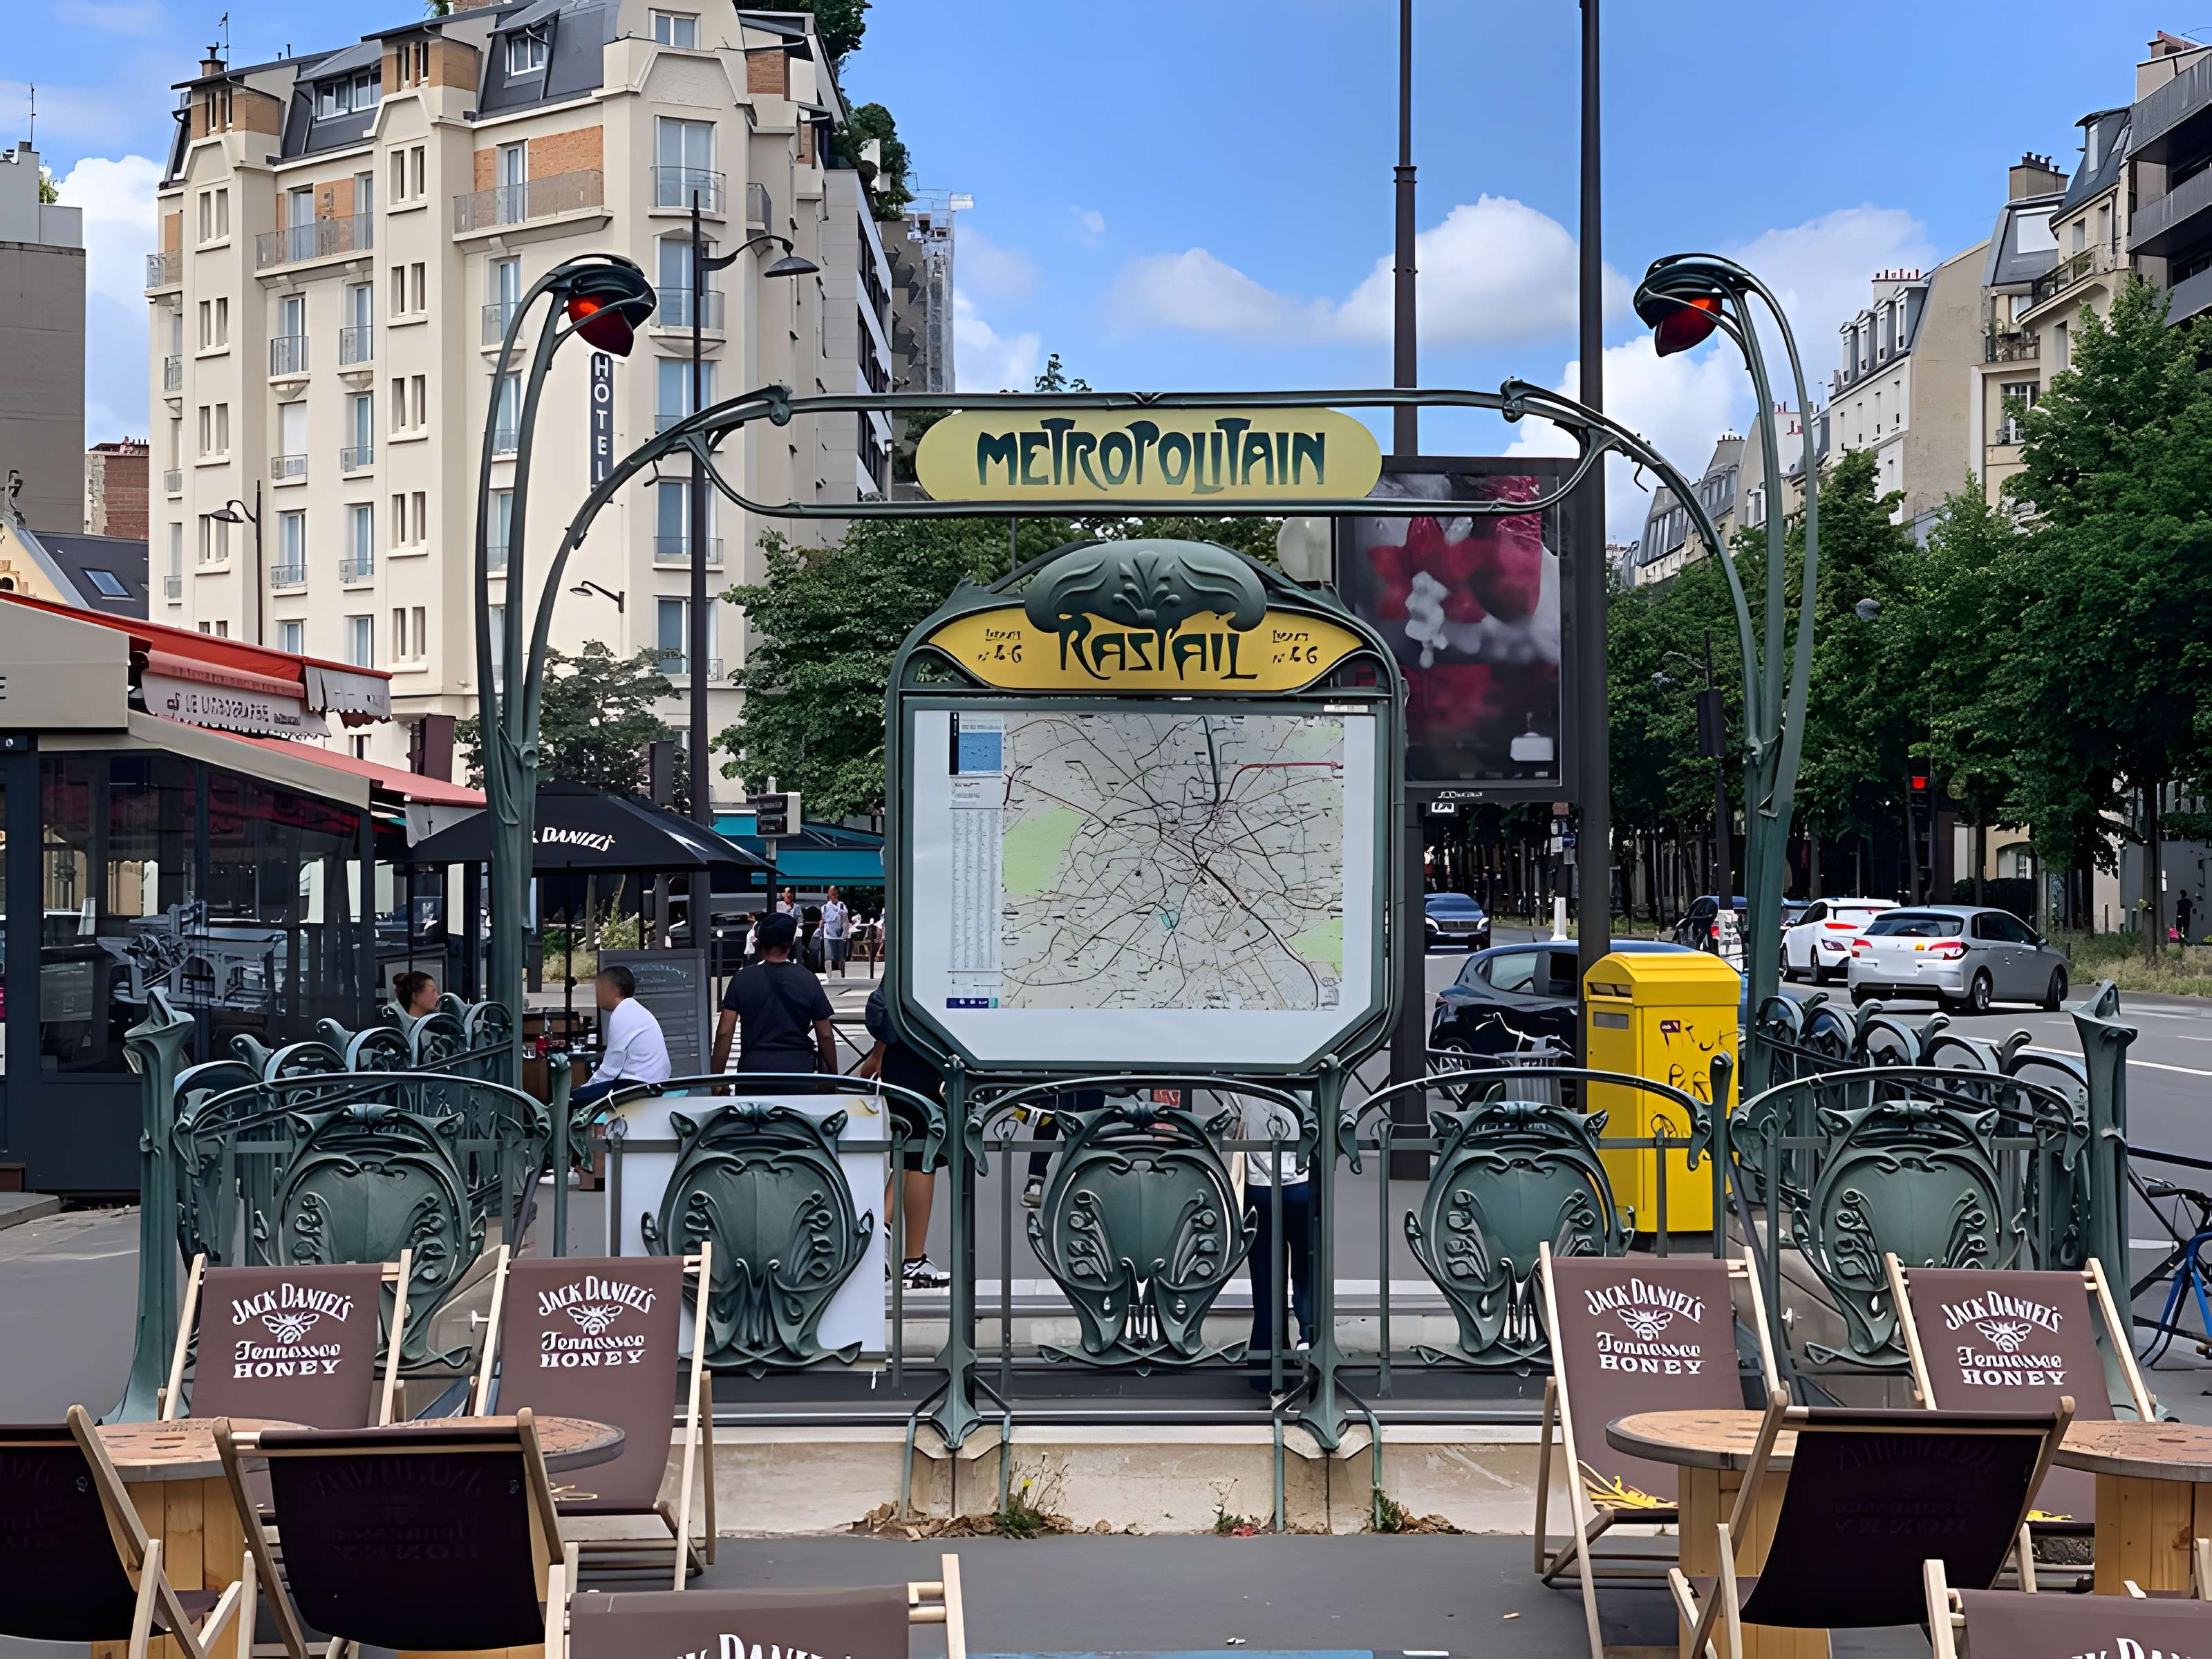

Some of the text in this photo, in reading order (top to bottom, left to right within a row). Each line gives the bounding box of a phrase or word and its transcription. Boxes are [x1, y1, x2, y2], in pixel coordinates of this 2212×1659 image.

[977, 418, 1325, 494] METROPOLITAIN
[232, 1290, 277, 1325] JACK
[538, 1282, 583, 1316] JACK
[1584, 1285, 1632, 1315] JACK
[1941, 1297, 1984, 1331] JACK
[233, 1359, 344, 1378] HONEY
[539, 1349, 646, 1368] HONEY
[1599, 1353, 1706, 1374] HONEY
[1960, 1369, 2068, 1386] HONEY
